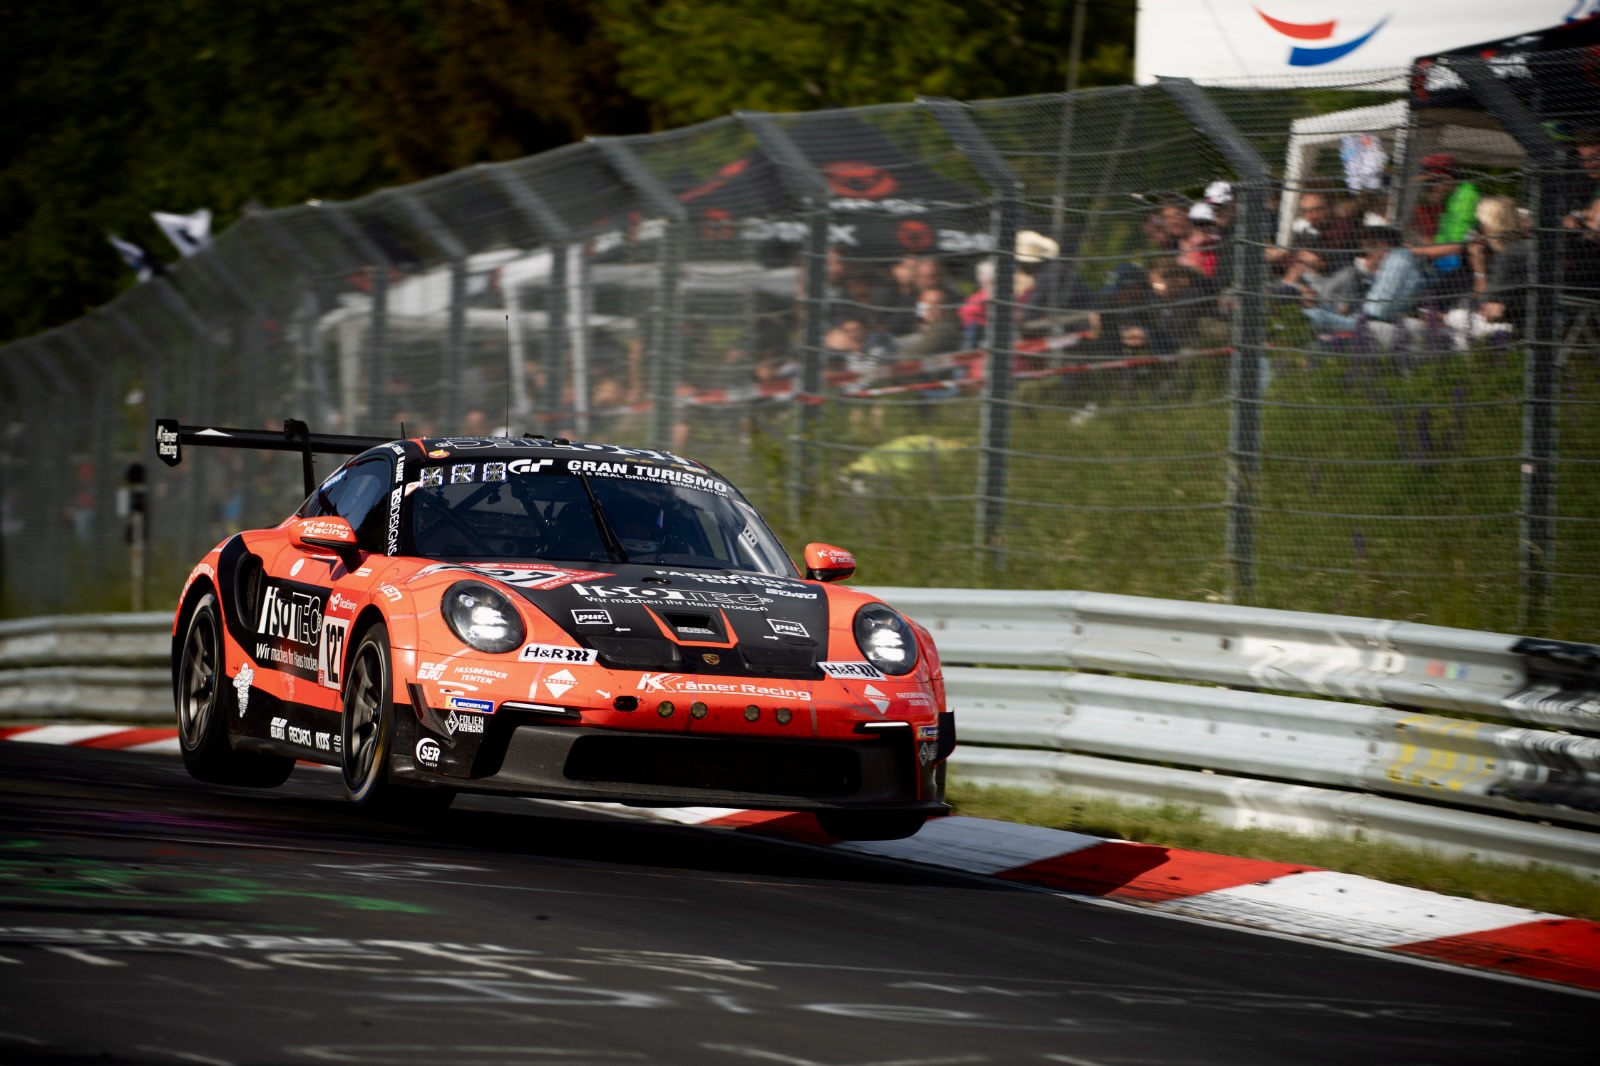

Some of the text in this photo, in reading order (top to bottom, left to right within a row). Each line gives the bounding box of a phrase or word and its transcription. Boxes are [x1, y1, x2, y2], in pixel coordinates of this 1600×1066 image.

[160, 443, 178, 459] Racing
[507, 458, 554, 475] GT
[567, 459, 728, 494] GRAN TURISMO
[594, 471, 622, 480] REAL
[624, 474, 668, 484] DRIVING
[670, 480, 729, 498] SIMULATOR
[298, 520, 351, 530] Krämer
[303, 526, 350, 539] Racing
[584, 596, 608, 604] Wir
[610, 597, 663, 606] machen
[685, 600, 719, 609] Haus
[721, 602, 769, 612] trocken
[256, 642, 271, 660] Wir
[325, 622, 345, 684] 127
[524, 646, 564, 659] H&R
[454, 666, 509, 680] FASSBENDER
[825, 664, 861, 675] H&R
[461, 674, 493, 685] TENTEN
[636, 673, 812, 702] Krämer Racing
[457, 701, 490, 710] MICHELIN
[459, 714, 485, 724] FOLIEN
[288, 725, 312, 747] RECARO
[458, 723, 484, 733] WERK
[420, 745, 441, 762] SER
